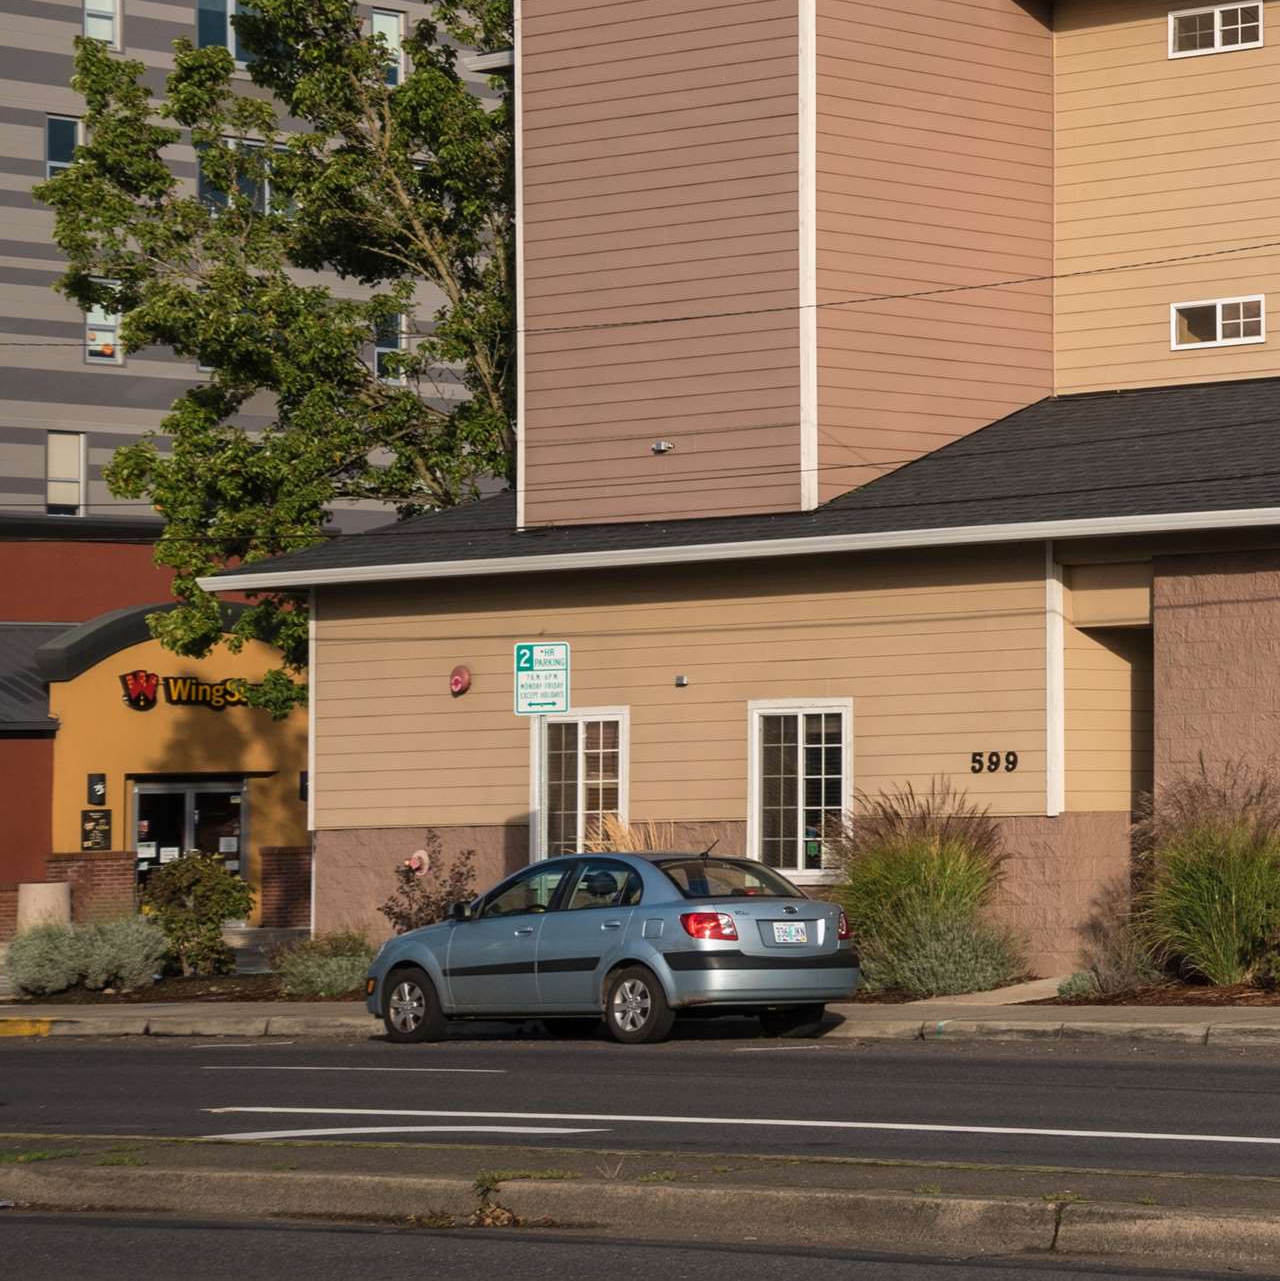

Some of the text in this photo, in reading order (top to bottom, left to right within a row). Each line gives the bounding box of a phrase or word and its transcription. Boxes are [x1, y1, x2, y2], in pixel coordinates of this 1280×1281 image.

[519, 649, 530, 668] 2
[534, 658, 565, 667] PARKING
[970, 750, 1018, 774] 599
